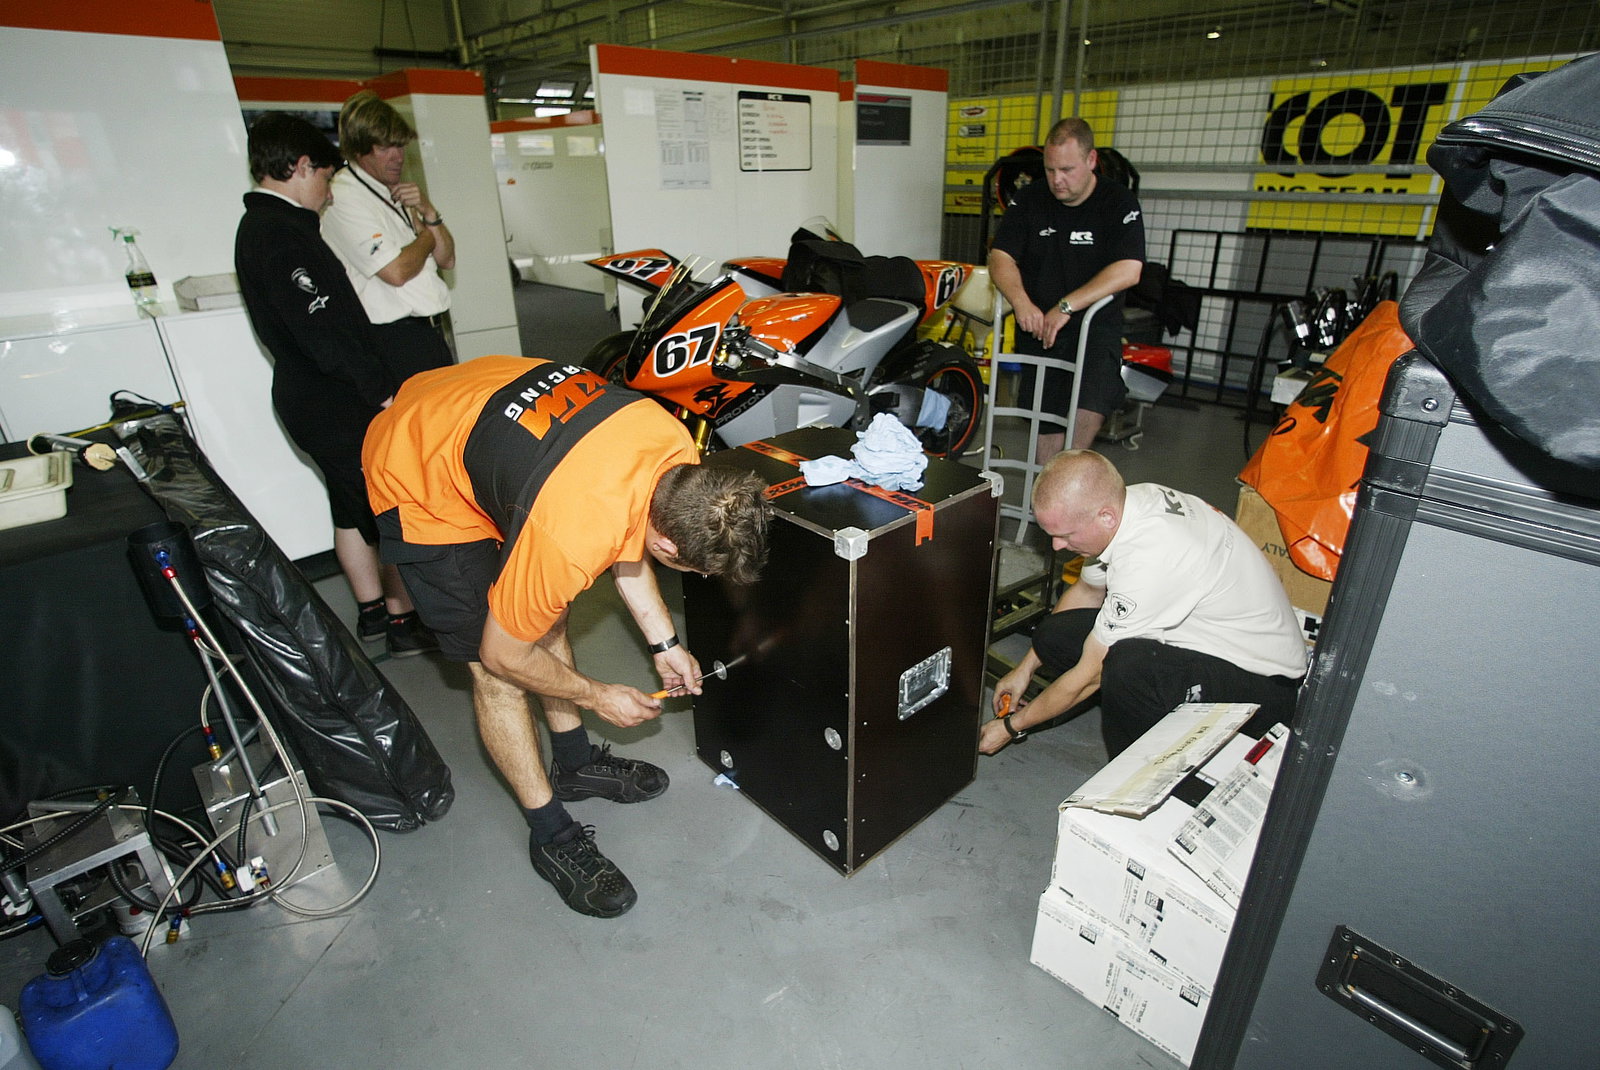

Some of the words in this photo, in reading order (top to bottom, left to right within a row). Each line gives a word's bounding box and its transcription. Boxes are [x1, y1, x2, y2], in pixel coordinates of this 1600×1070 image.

[653, 322, 720, 378] 67
[517, 370, 608, 441] KTM
[715, 389, 766, 426] PROTON
[1261, 542, 1290, 560] ALY
